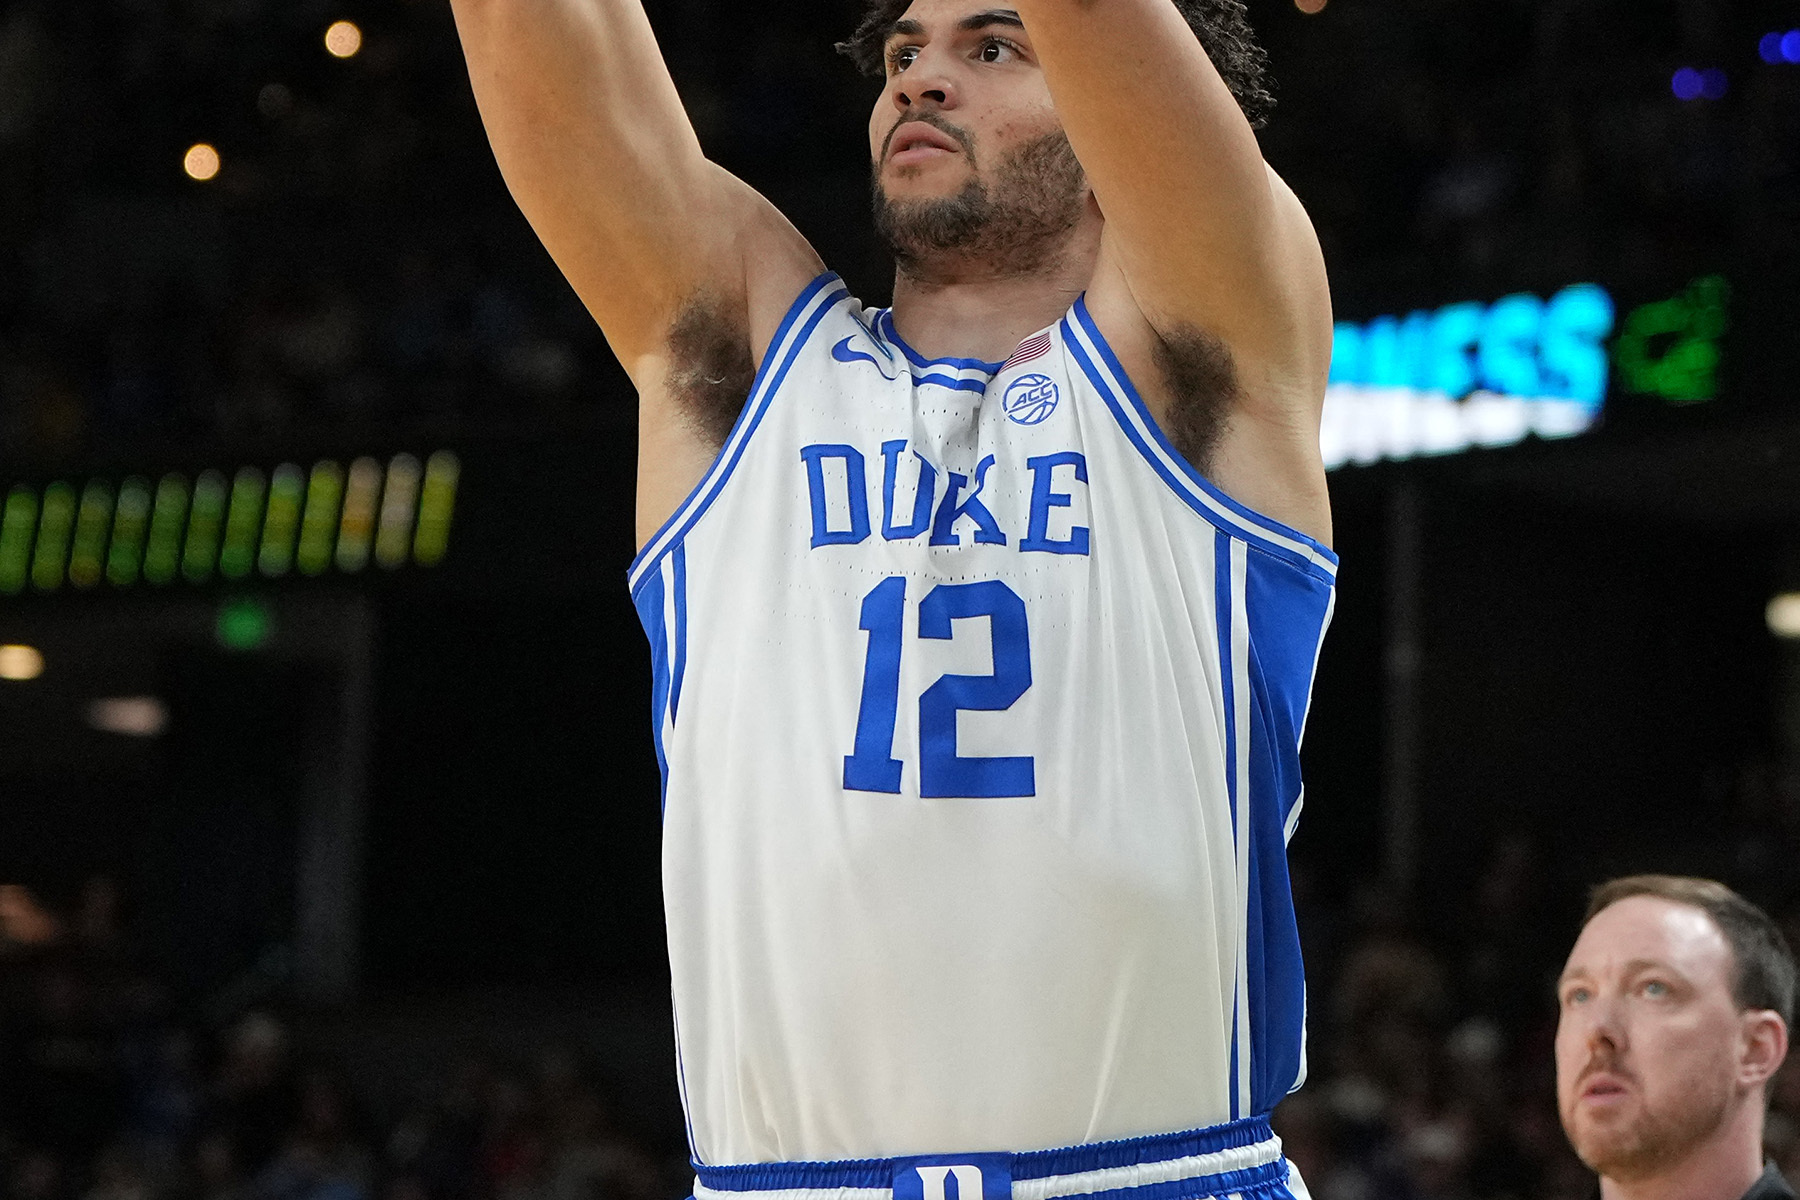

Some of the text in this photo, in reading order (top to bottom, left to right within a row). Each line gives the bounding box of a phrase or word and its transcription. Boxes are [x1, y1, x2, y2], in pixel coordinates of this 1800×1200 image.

[1011, 380, 1053, 408] ACC
[799, 439, 1090, 556] DUKE
[842, 576, 1036, 799] 12
